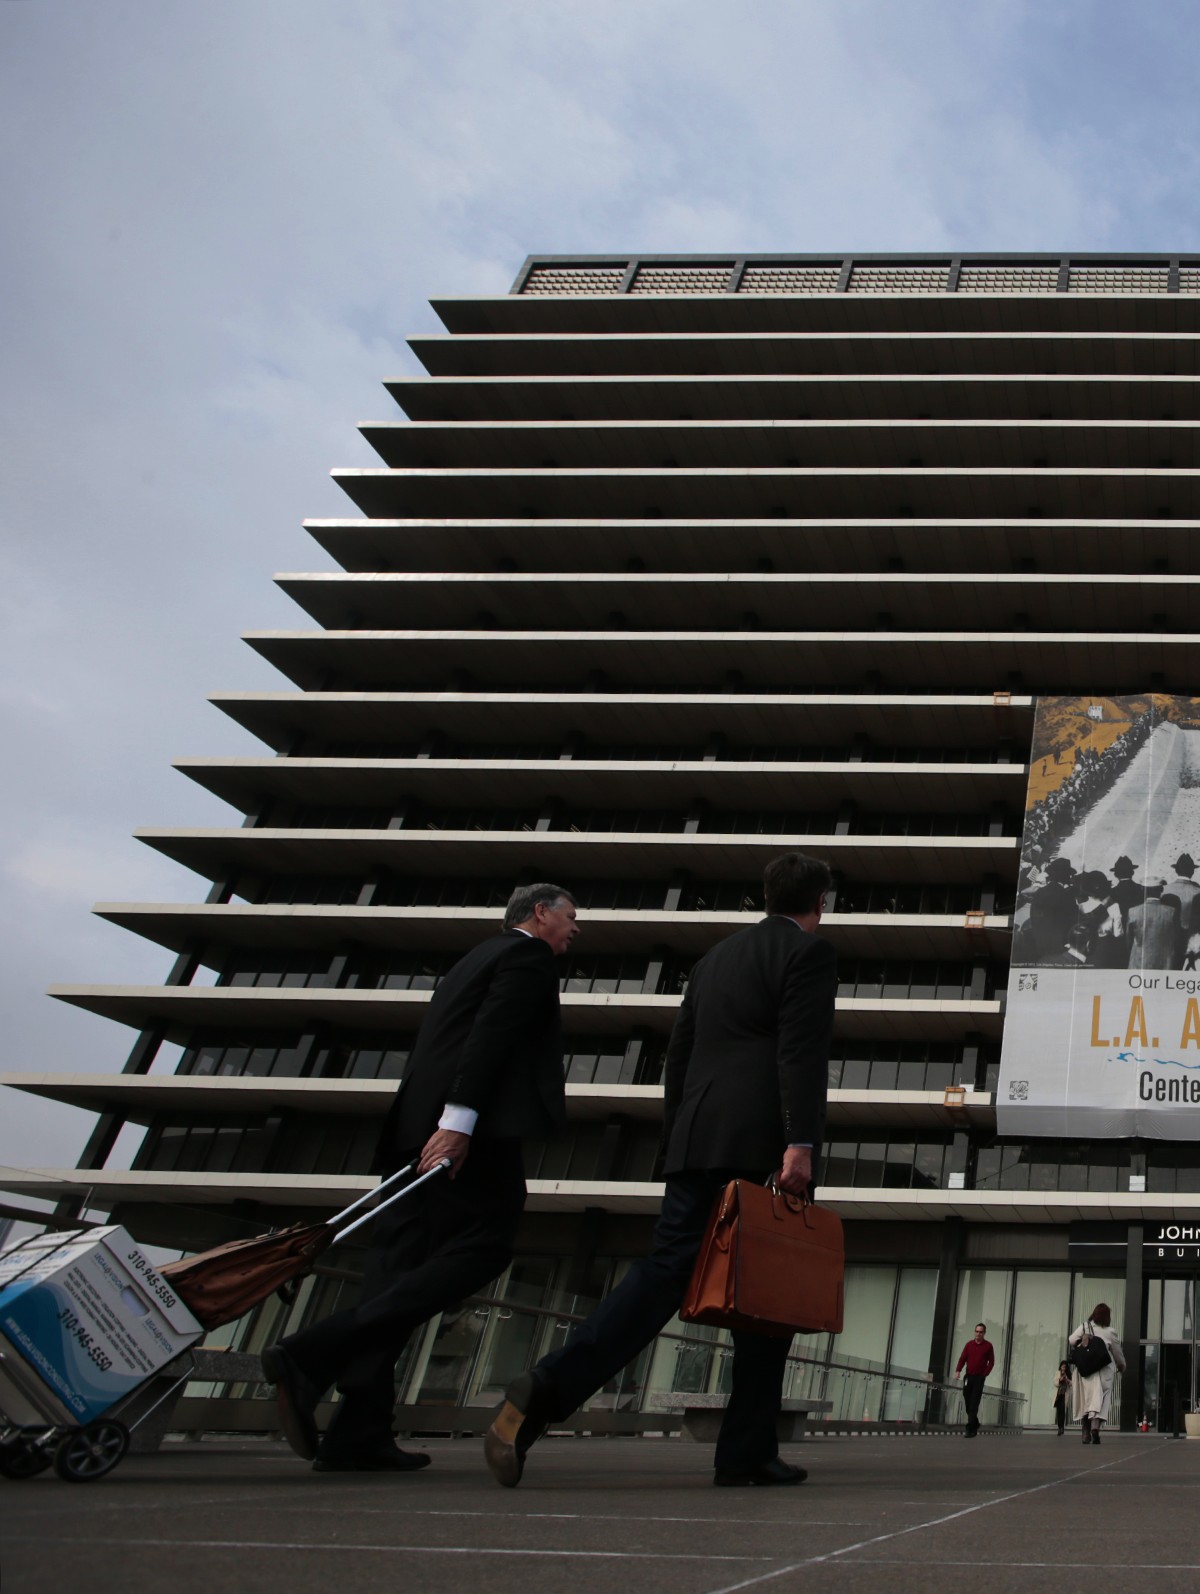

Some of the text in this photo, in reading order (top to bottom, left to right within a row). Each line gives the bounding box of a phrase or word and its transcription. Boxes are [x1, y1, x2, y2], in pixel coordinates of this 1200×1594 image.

[1128, 974, 1160, 990] Our
[1090, 995, 1160, 1049] L.A.
[128, 1250, 177, 1309] 310-945-5550
[57, 1307, 113, 1373] 310-945-5550
